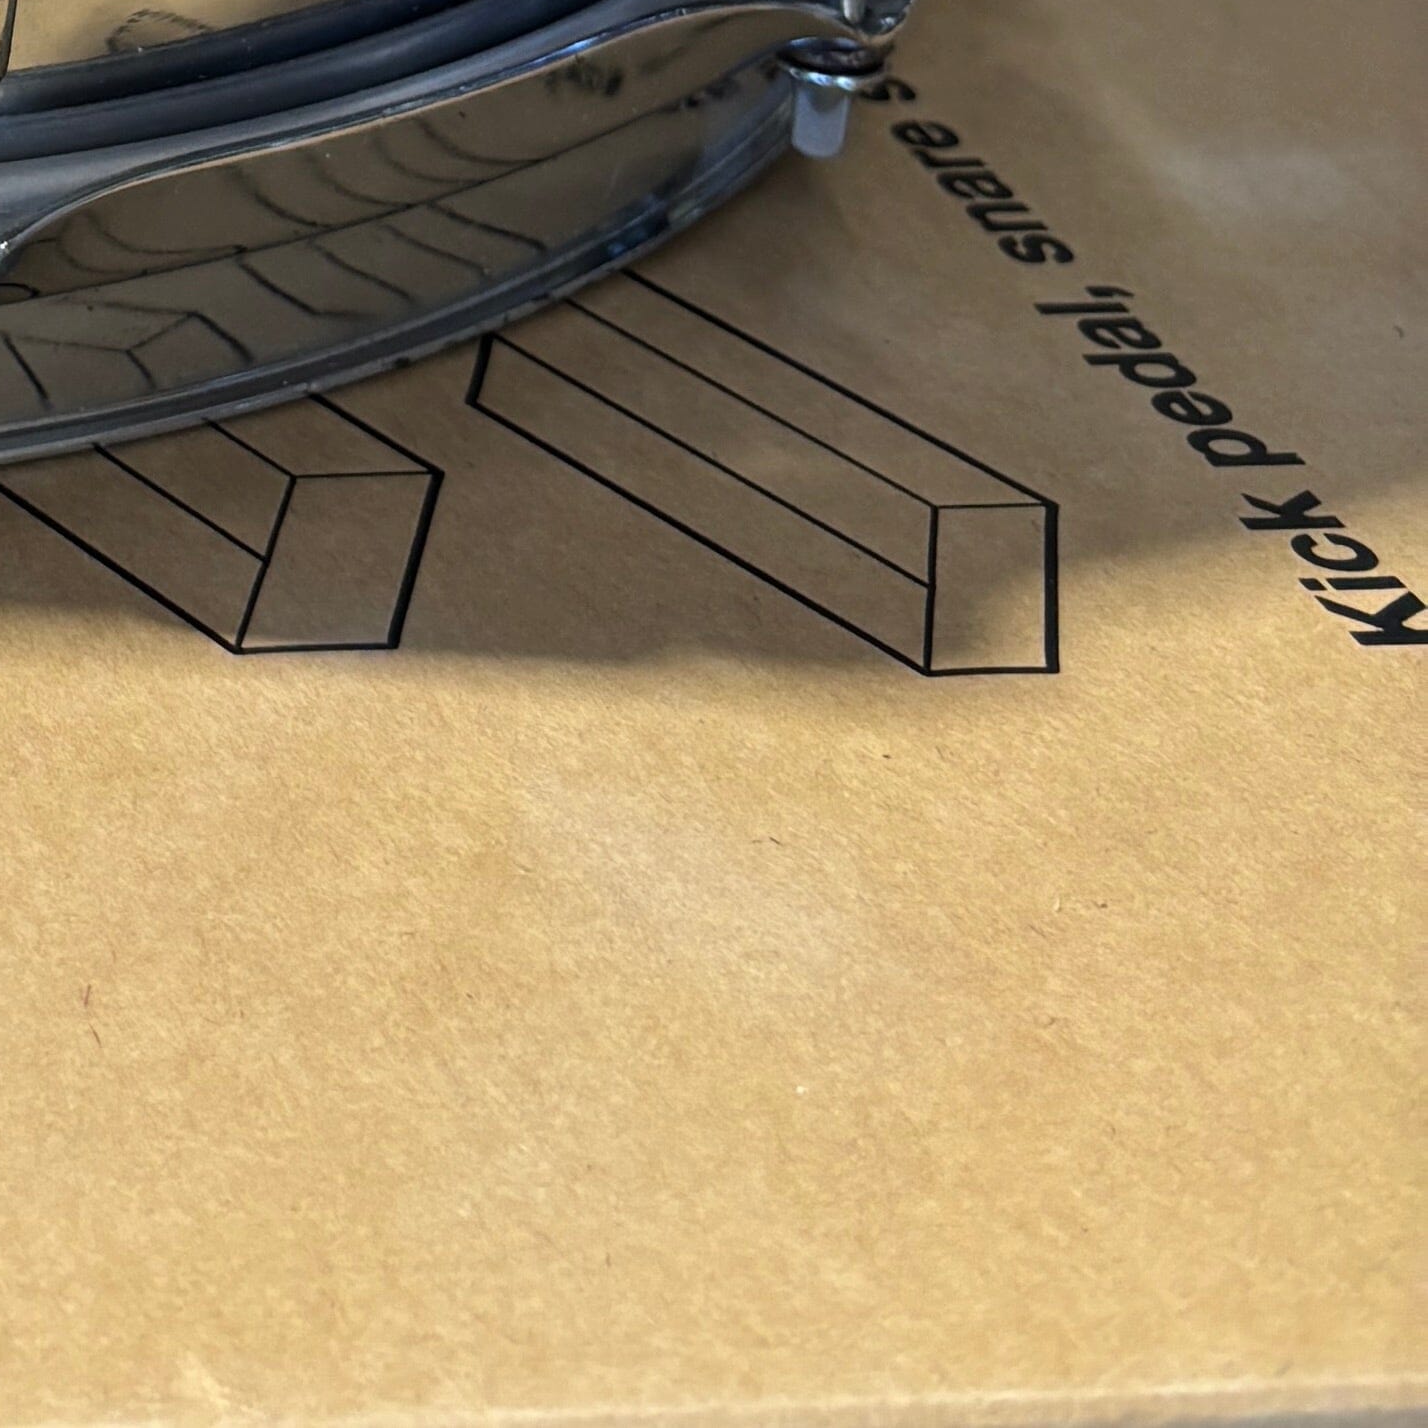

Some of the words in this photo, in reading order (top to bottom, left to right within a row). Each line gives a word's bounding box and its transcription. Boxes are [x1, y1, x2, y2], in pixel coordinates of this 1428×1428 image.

[890, 119, 1075, 265] snare
[1033, 285, 1306, 468] pedal,
[1238, 489, 1428, 646] Kick
